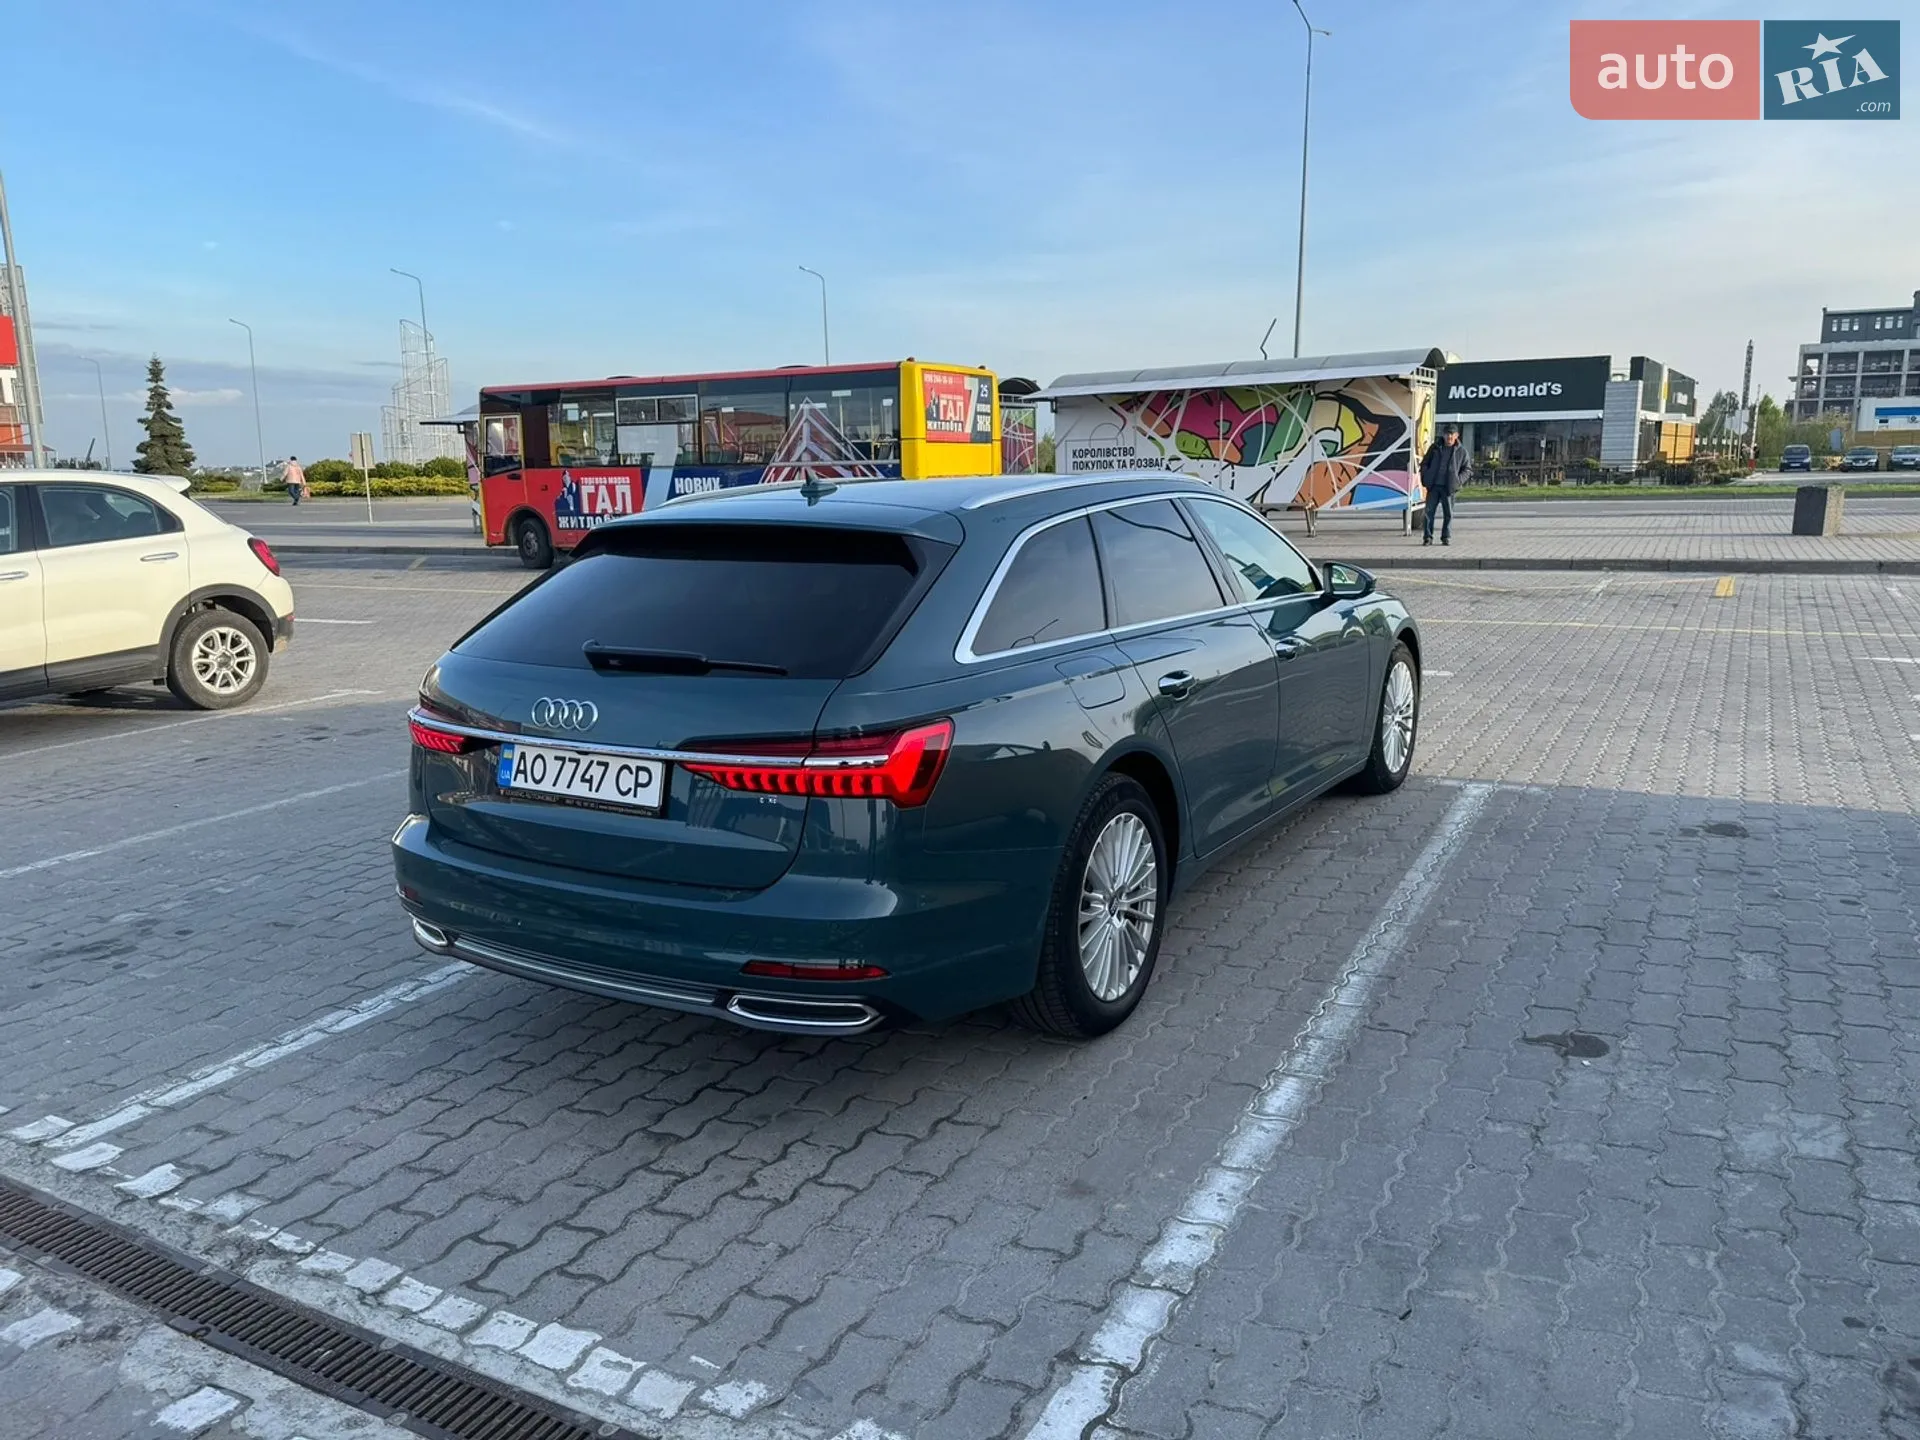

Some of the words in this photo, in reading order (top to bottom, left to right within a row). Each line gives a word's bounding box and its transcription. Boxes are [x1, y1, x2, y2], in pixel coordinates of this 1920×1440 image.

[1448, 381, 1563, 399] McDonald's
[939, 400, 964, 421] ГАЛ
[1072, 446, 1135, 459] КОРОЛІВСТВО
[1072, 459, 1115, 471] ПОКУПОК
[1117, 458, 1128, 469] ТА
[1130, 457, 1165, 469] РОЗВАГ
[674, 477, 721, 494] НОВИХ
[580, 484, 632, 514] ГАЛ
[501, 771, 511, 779] UA
[513, 751, 547, 785] AO
[552, 755, 610, 793] 7747
[615, 763, 653, 798] CP
